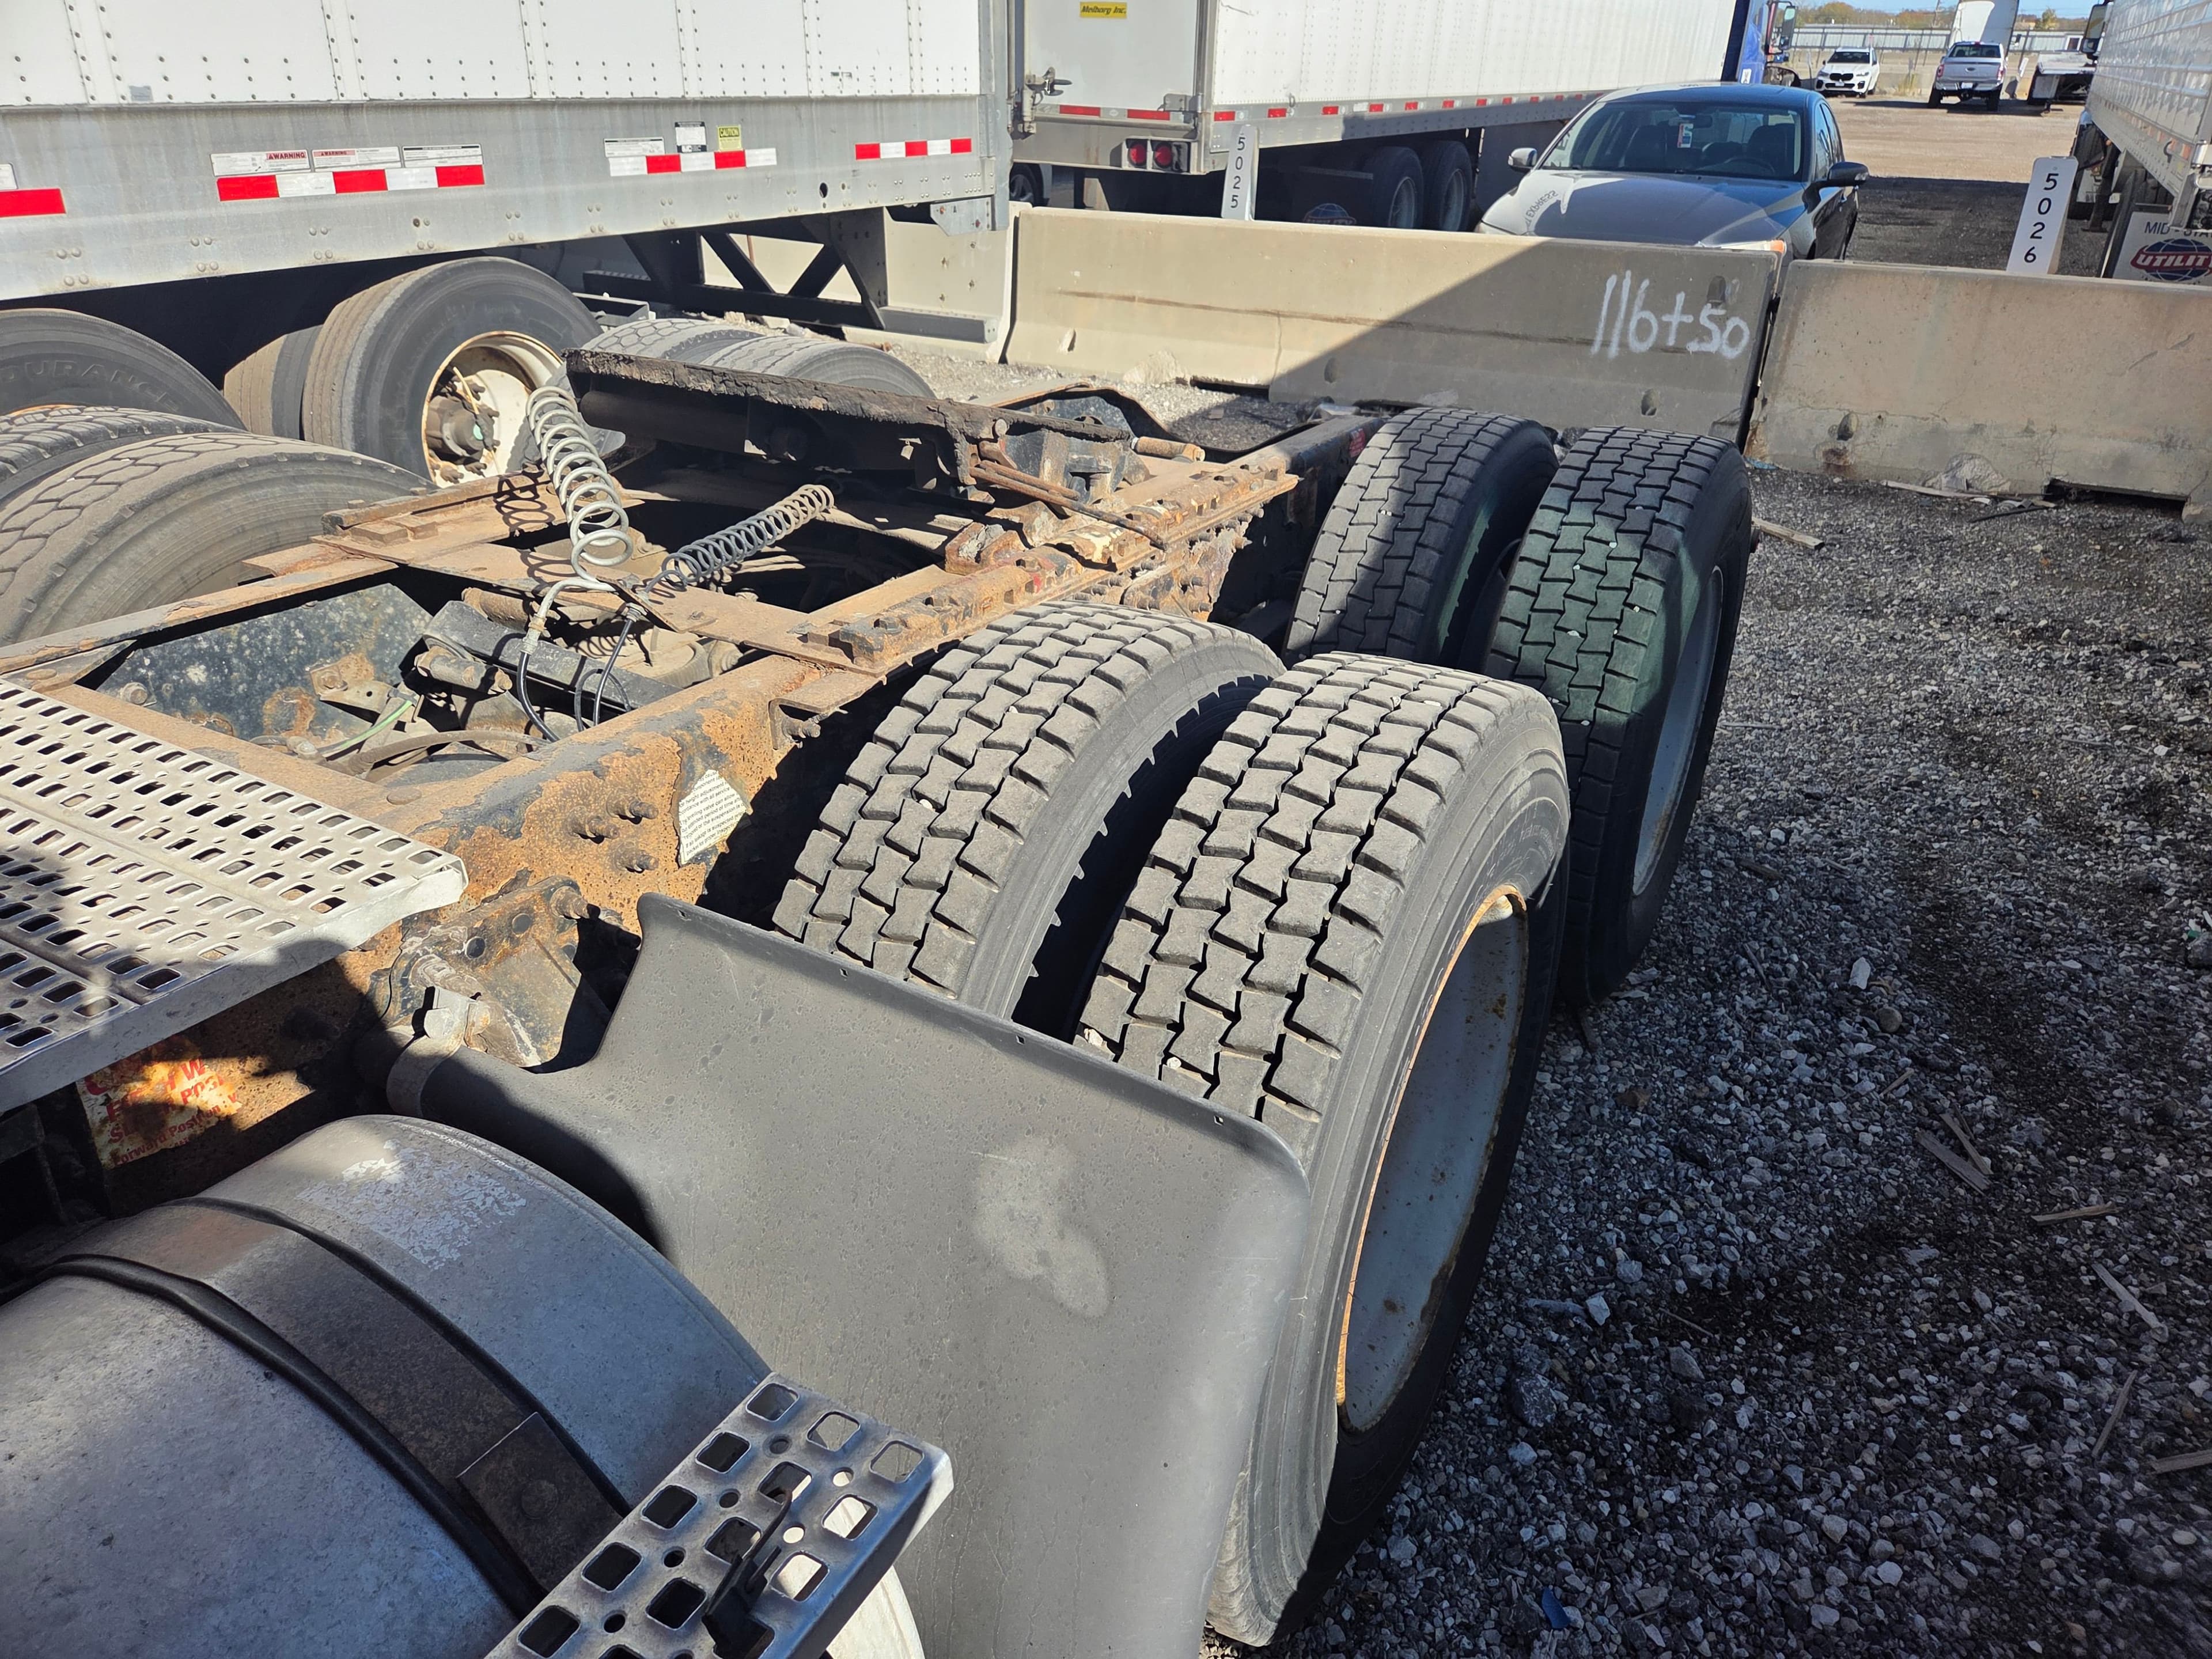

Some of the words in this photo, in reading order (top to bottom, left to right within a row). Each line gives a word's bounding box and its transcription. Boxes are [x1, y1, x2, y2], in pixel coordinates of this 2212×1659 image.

[272, 151, 306, 160] WARNING
[1230, 137, 1246, 209] 5025
[2024, 172, 2059, 263] 5026
[2144, 221, 2171, 235] MID
[2136, 253, 2212, 267] UTILIT
[693, 778, 715, 791] omponent
